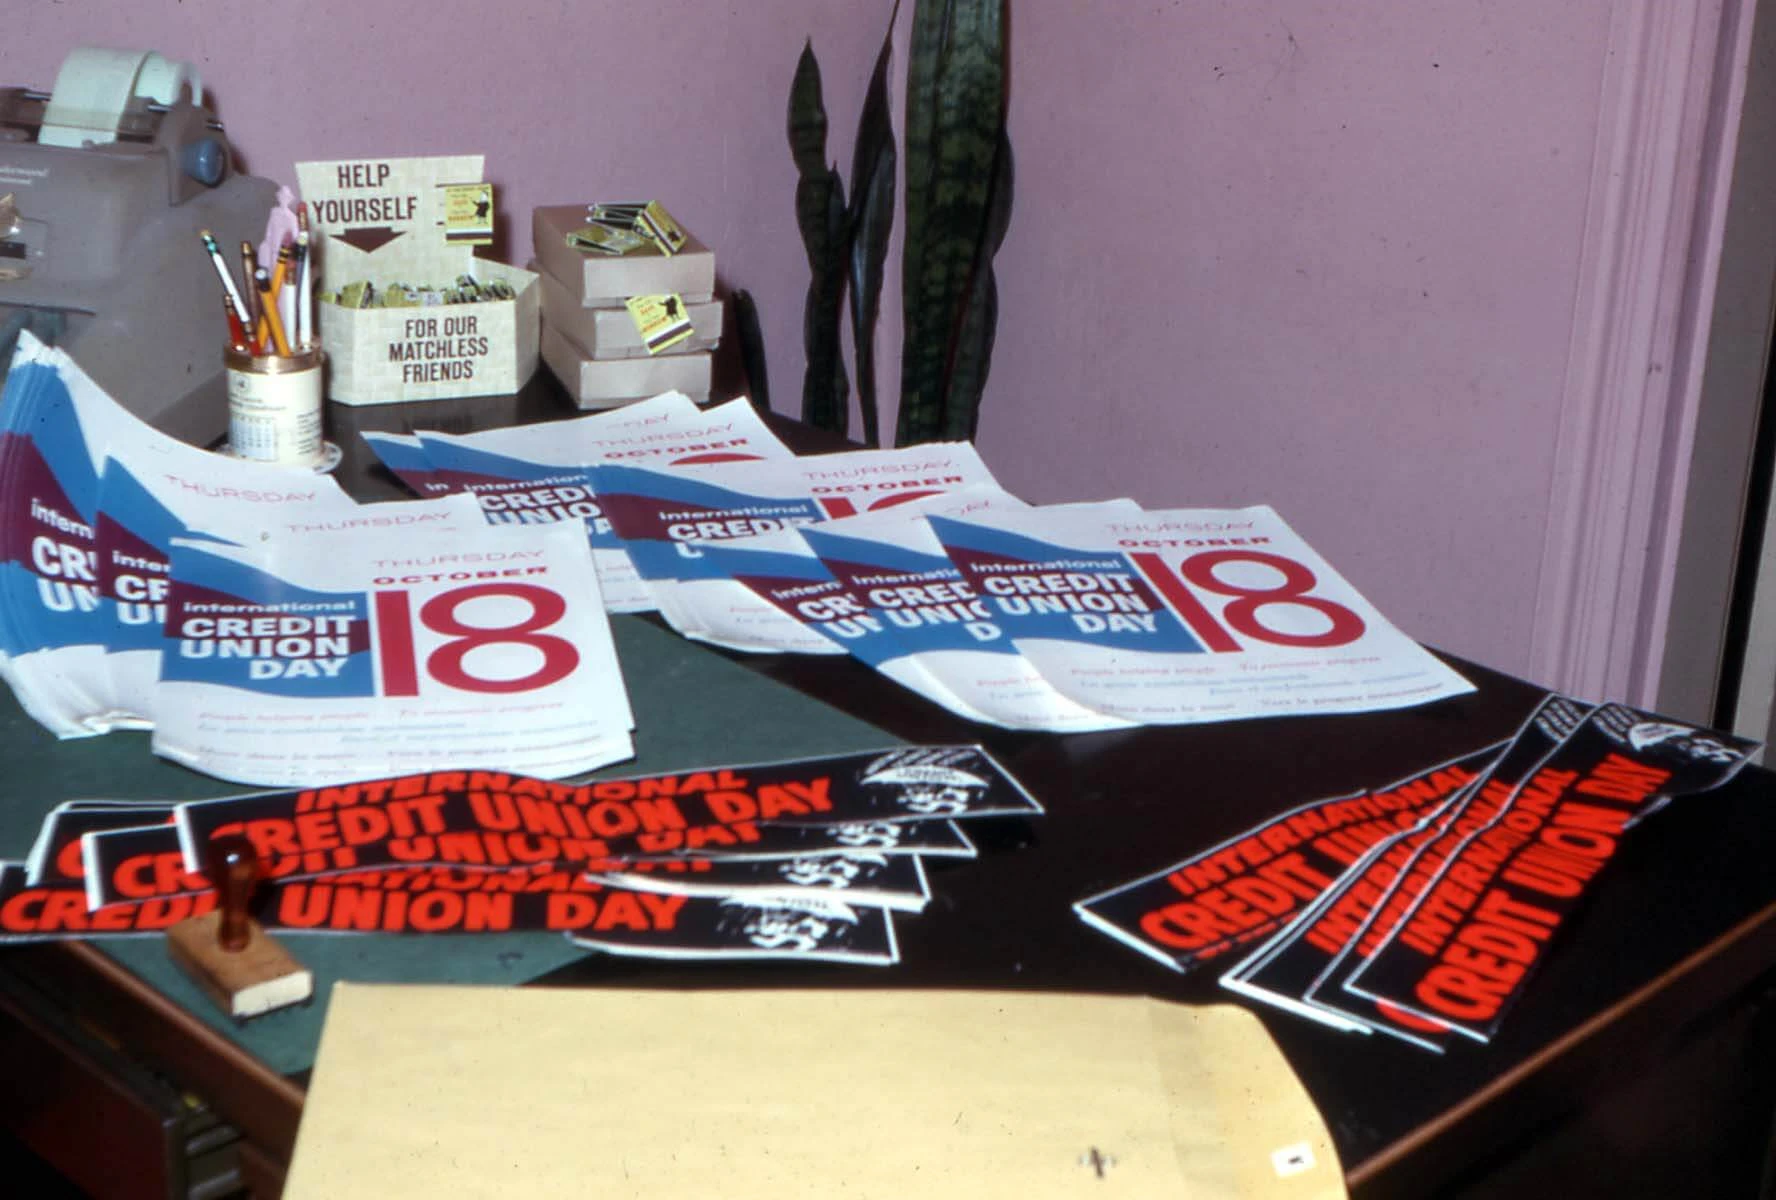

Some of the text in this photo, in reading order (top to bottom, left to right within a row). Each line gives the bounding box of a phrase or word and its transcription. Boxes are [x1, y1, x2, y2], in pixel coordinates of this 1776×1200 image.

[337, 163, 390, 188] HELP
[312, 196, 417, 224] YOURSELF
[405, 316, 478, 339] FOR OUR
[389, 337, 488, 362] MATCHLESS
[403, 360, 474, 383] FRIENDS
[604, 437, 748, 459] OCTOBER
[804, 458, 953, 480] THURSDAY
[165, 473, 317, 504] THURSDAY
[811, 475, 964, 494] OCTOBER
[659, 494, 808, 521] international
[288, 511, 452, 534] THURSDAY
[1106, 520, 1254, 534] THURSDAY
[1118, 536, 1272, 549] OCTOBER
[372, 550, 545, 569] THURSDAY
[970, 558, 1122, 573] international
[373, 566, 549, 585] OCTOBER
[983, 573, 1134, 596] CREDIT
[183, 600, 356, 614] international
[995, 593, 1151, 618] UNION
[1129, 549, 1367, 654] 18
[181, 615, 357, 638] CREDIT
[1070, 612, 1159, 635] DAY
[180, 636, 349, 658] UNION
[374, 582, 580, 697] 18
[249, 658, 348, 680] DAY
[295, 769, 747, 813] INTERNATIONAL
[468, 789, 689, 840] UNION
[706, 776, 832, 825] DAY
[1166, 764, 1477, 896] INTERNATIONAL
[1400, 767, 1580, 957] INTERNATIONAL
[1415, 752, 1672, 1021] CREDIT UNION DAY
[0, 883, 689, 932] CREDI UNION DAY
[1140, 849, 1336, 950] CREDIT
